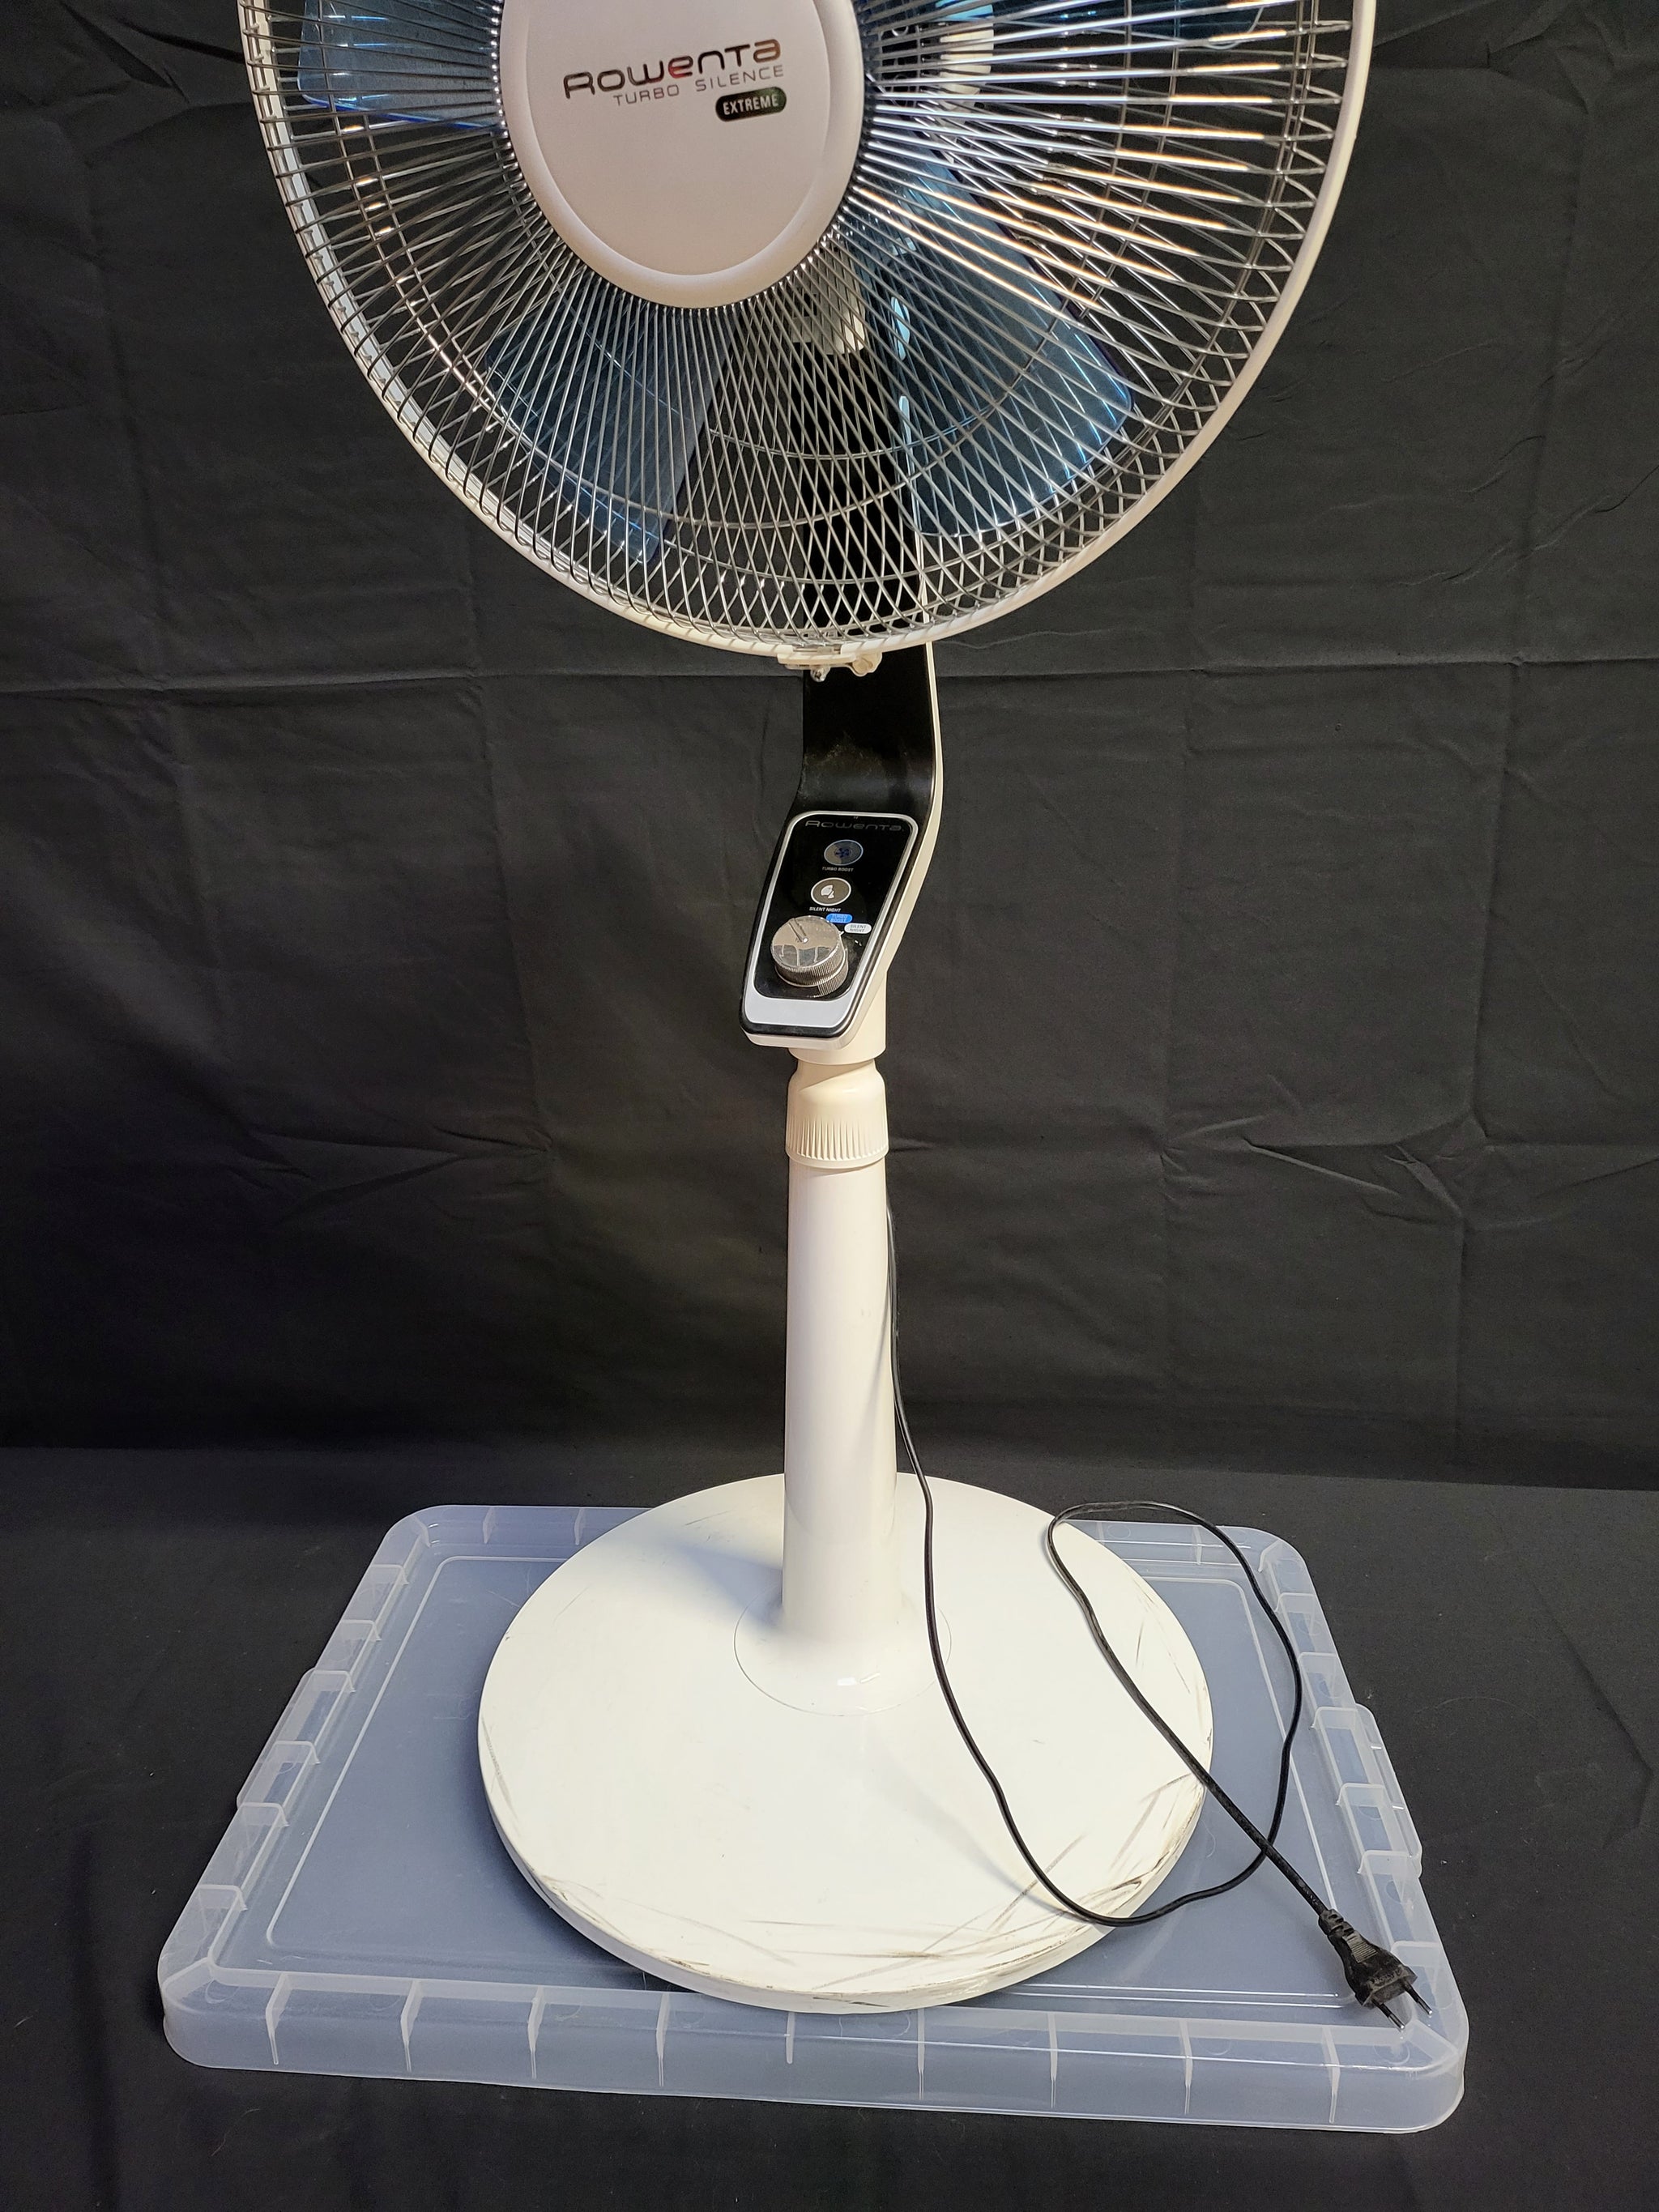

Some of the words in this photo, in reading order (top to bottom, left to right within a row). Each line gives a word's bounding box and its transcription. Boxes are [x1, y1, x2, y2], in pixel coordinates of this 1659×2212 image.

[613, 84, 680, 106] TURBO
[695, 65, 784, 92] SILENCE
[723, 93, 779, 115] EXTREME
